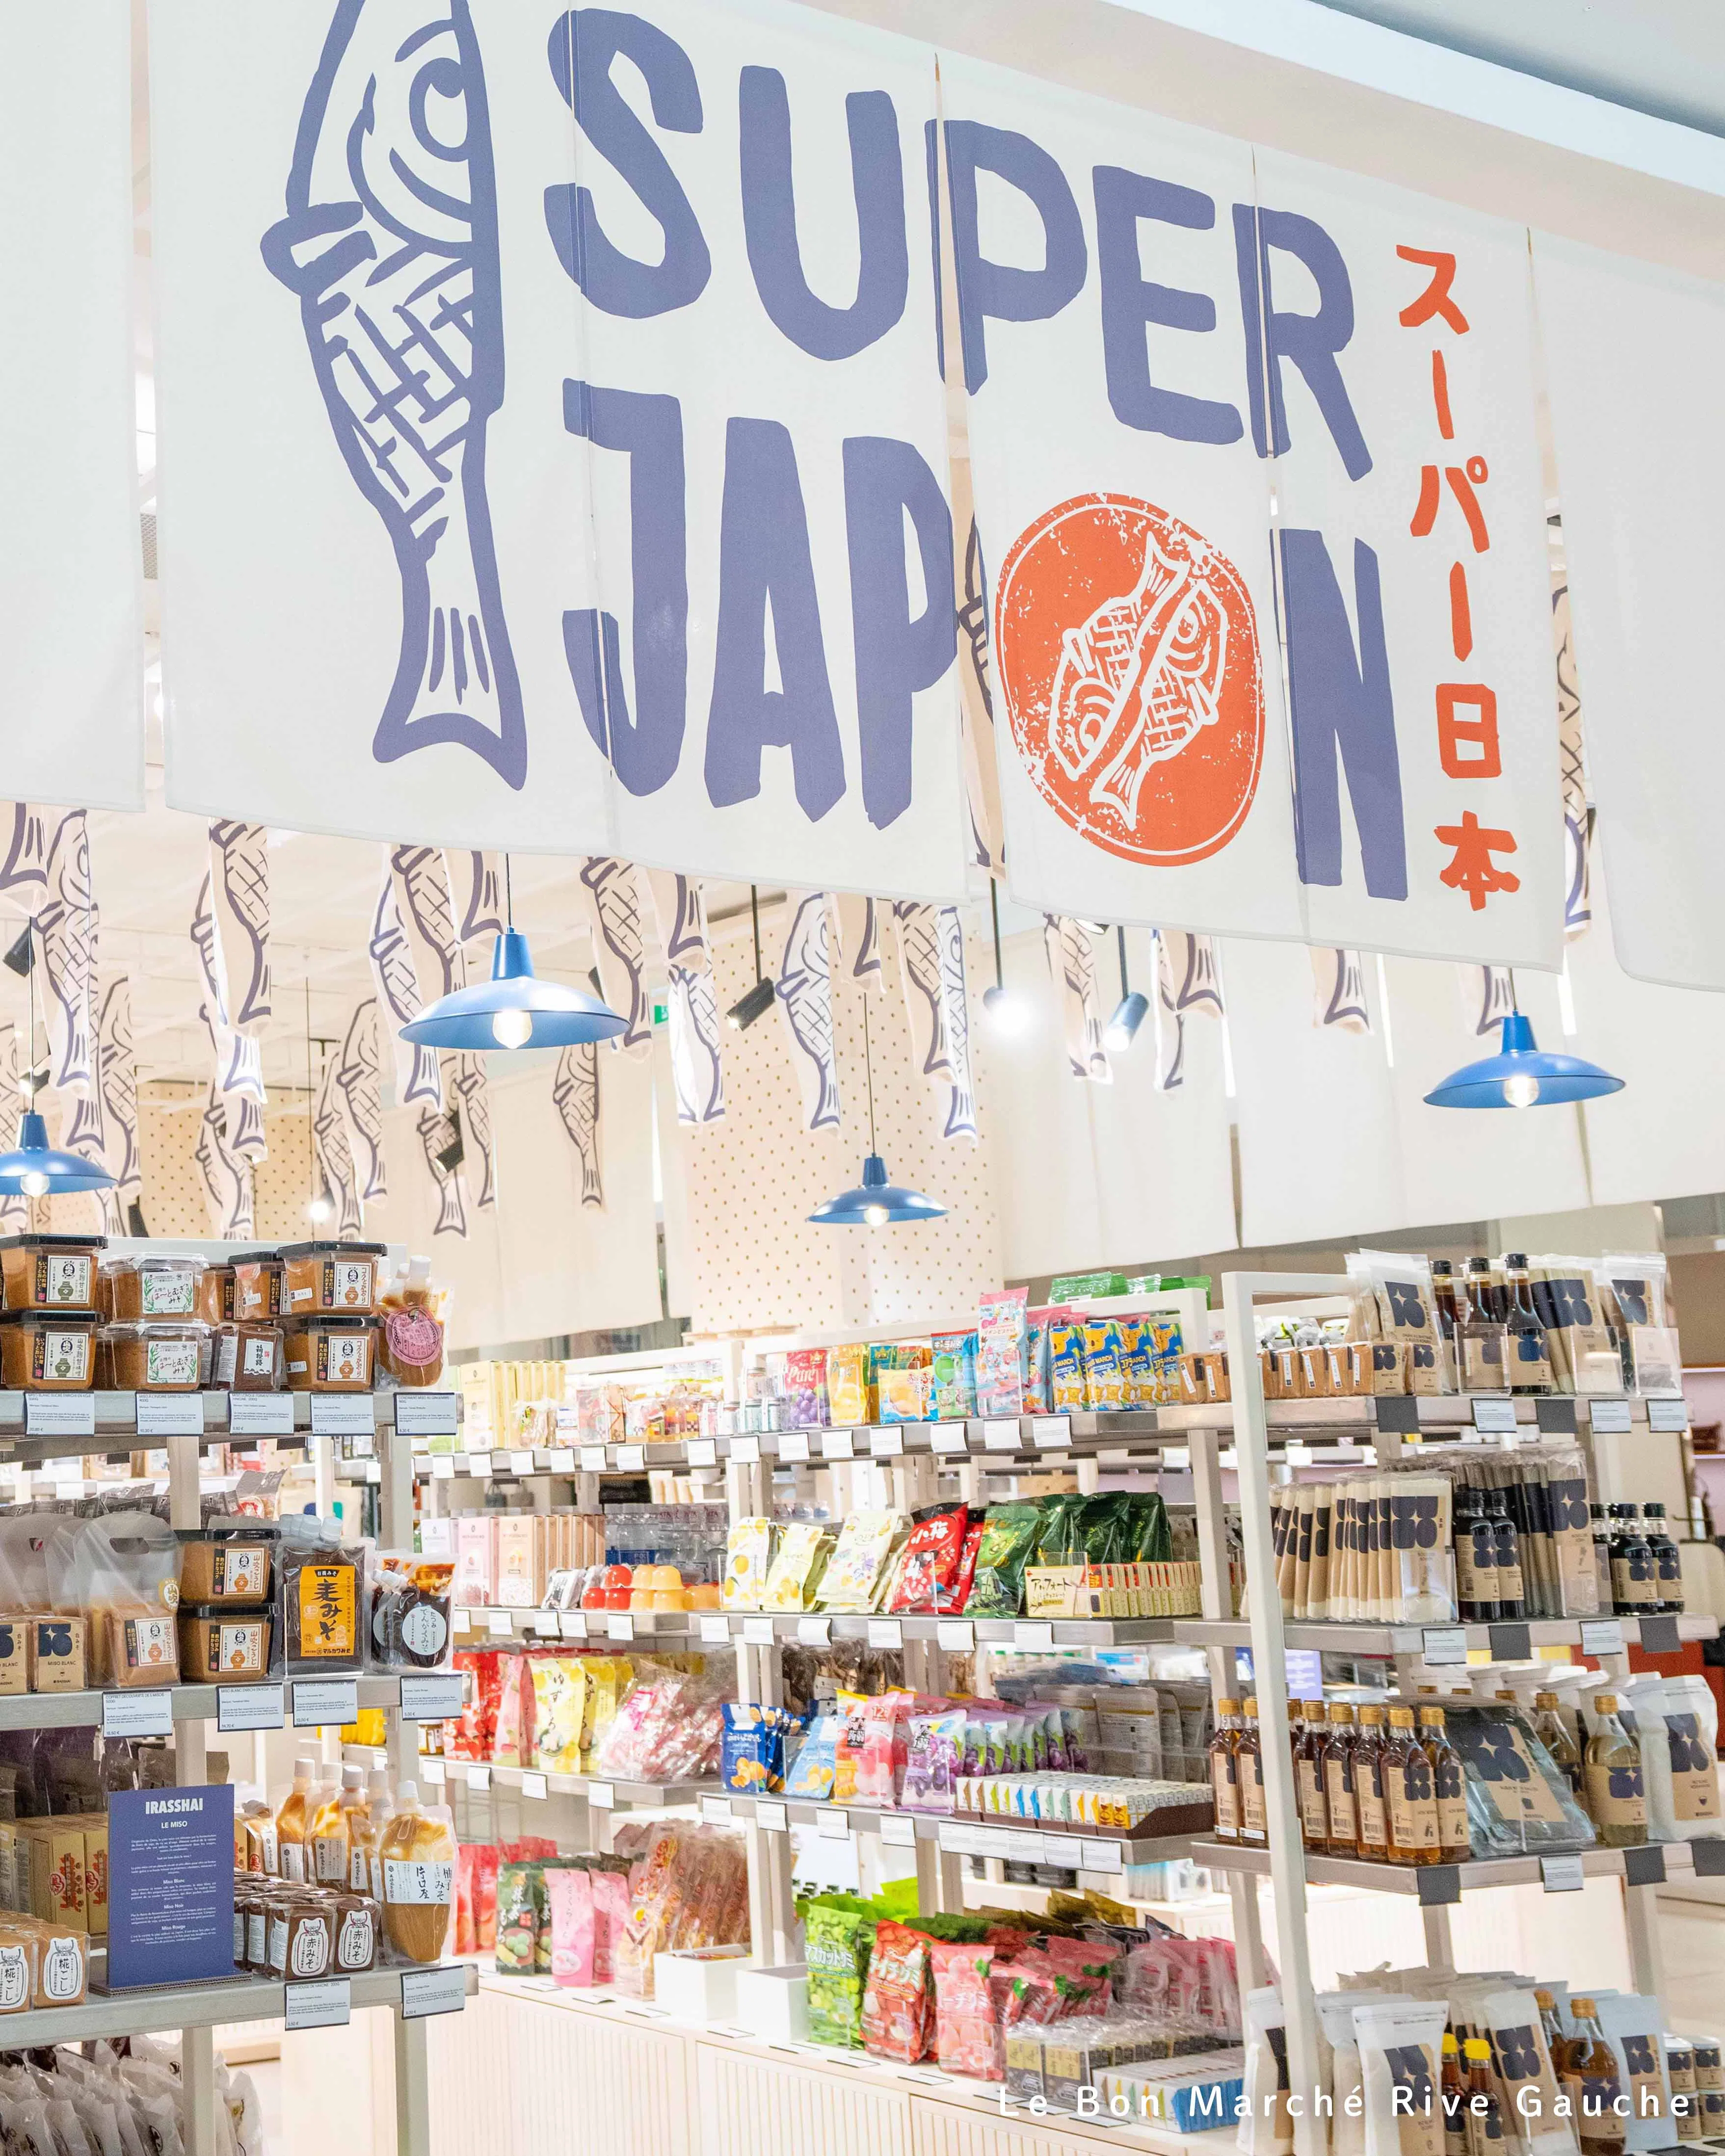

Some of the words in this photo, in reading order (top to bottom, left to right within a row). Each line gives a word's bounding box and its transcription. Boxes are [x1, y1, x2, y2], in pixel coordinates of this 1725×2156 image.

[544, 7, 1373, 482] SUPER
[1396, 244, 1520, 911] スーパー日本
[910, 1521, 949, 1545] 小梅
[311, 1578, 343, 1640] 麦みそ
[145, 1798, 203, 1814] IRASSHAI
[435, 1880, 445, 1901] みそ
[306, 1938, 317, 1969] 赤みそ
[352, 1930, 363, 1961] 赤みそ
